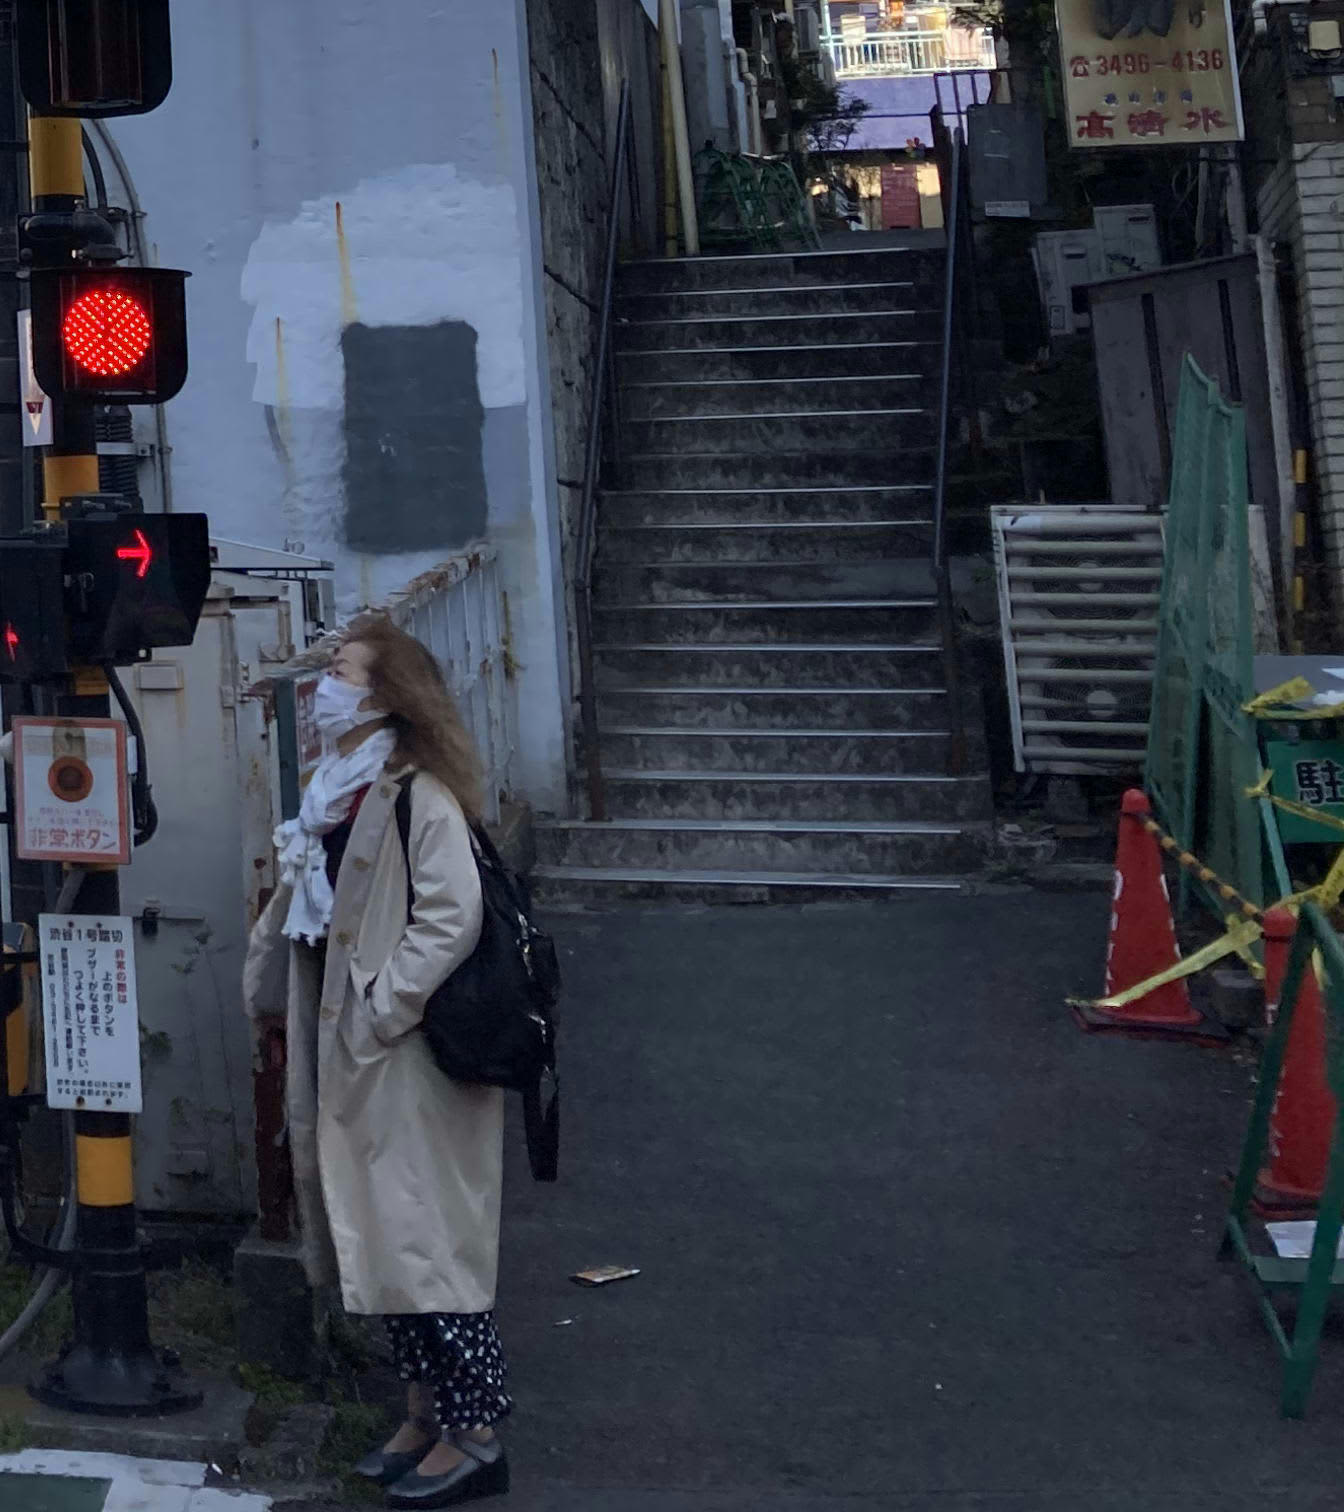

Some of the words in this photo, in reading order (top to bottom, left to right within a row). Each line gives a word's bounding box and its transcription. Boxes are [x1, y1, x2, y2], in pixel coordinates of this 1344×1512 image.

[1096, 49, 1223, 76] 3496-4136
[29, 827, 117, 849] 非常ボタン
